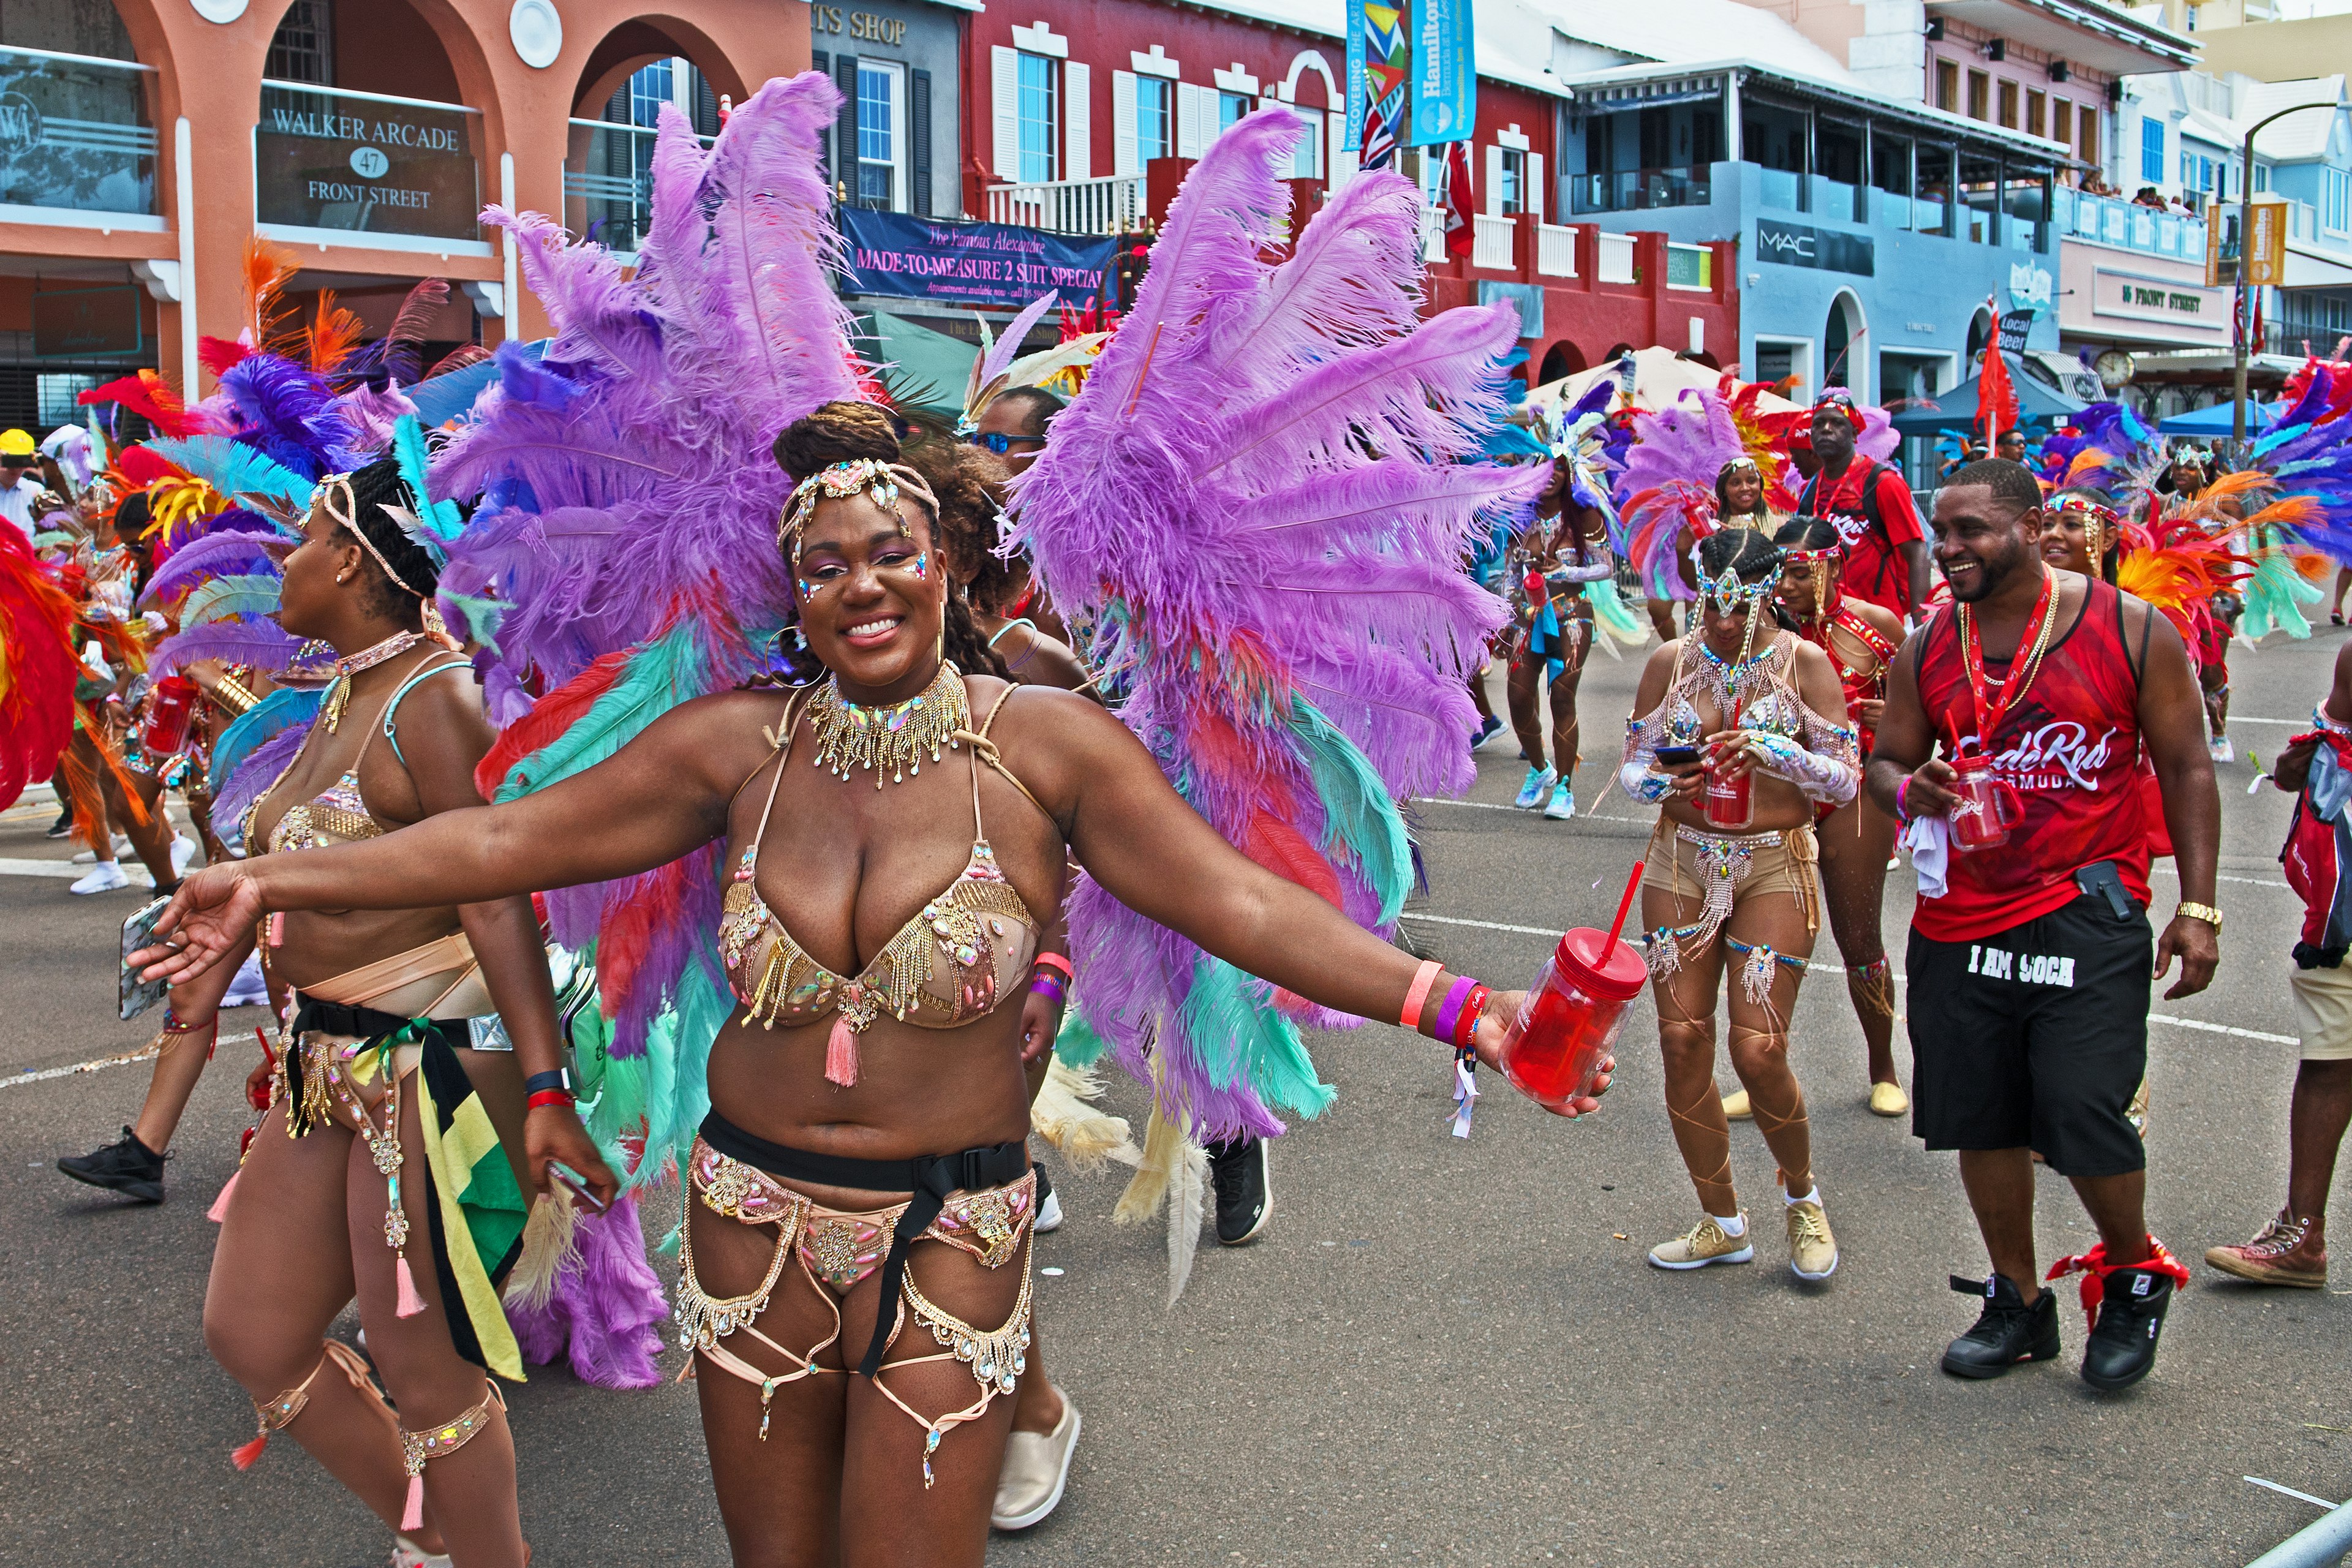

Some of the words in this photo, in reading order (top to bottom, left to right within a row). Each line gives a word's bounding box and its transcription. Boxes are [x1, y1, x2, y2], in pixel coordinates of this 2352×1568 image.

[812, 4, 842, 34] TS
[850, 12, 907, 47] SHOP
[1352, 32, 1361, 53] THE
[1349, 59, 1362, 148] DISCOVERING
[272, 108, 368, 141] WALKER
[372, 121, 459, 152] ARCADE
[359, 152, 379, 173] 47
[308, 180, 366, 203] FRONT
[369, 186, 431, 209] STREET
[929, 225, 949, 245] The
[951, 228, 991, 249] Famous
[993, 231, 1046, 255] Alexandre
[857, 248, 1001, 281] MADE-TO-MEASURE
[1005, 260, 1013, 282] 2
[1016, 262, 1049, 285] SUIT
[927, 281, 967, 295] Appointments
[968, 284, 993, 296] available
[993, 288, 1006, 297] now
[1011, 286, 1023, 298] call
[2136, 287, 2166, 308] FRONT
[2169, 292, 2201, 314] STREET
[949, 320, 966, 335] The
[970, 322, 1003, 336] Enish
[1036, 326, 1058, 343] Shop
[2001, 315, 2030, 333] Local
[1999, 331, 2026, 350] Beer
[1951, 721, 2117, 791] CdeRed
[1996, 772, 2075, 790] ERMUDA
[1968, 944, 1981, 973] I
[1981, 948, 2013, 980] AM
[2019, 954, 2076, 987] SOCA
